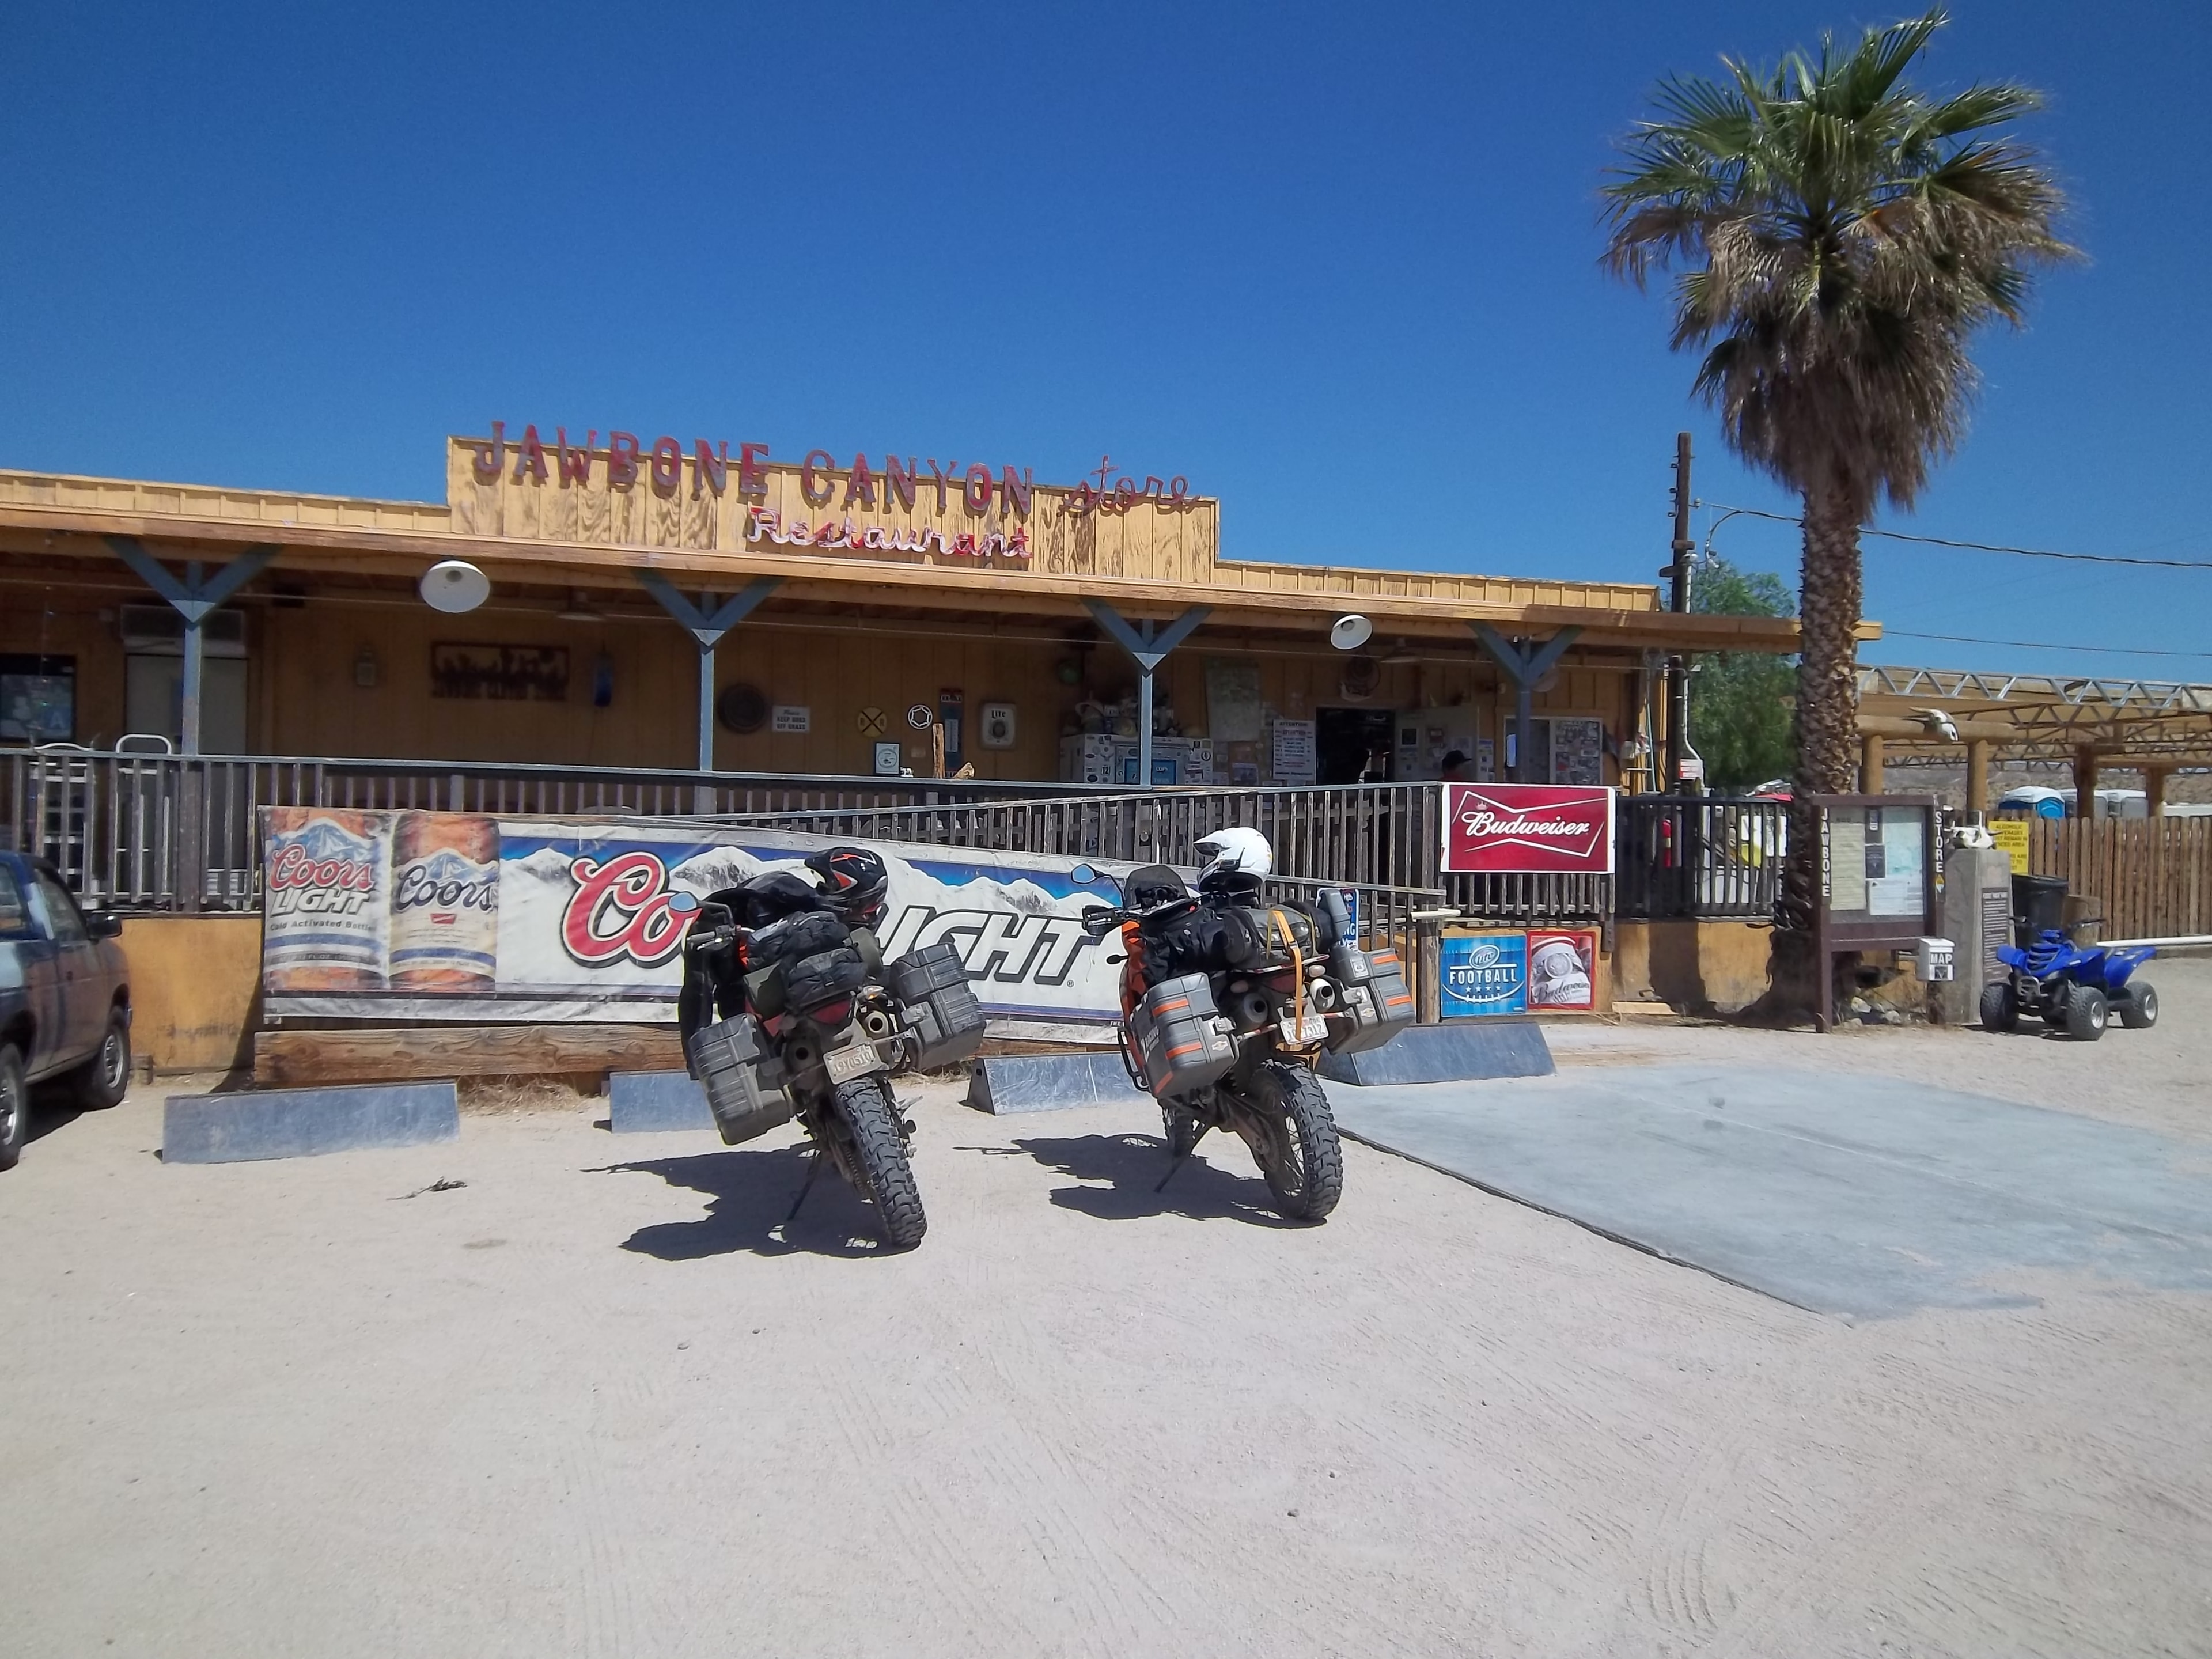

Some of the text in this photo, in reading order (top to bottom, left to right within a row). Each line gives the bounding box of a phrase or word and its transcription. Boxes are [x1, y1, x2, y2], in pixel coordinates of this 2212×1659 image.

[473, 421, 1201, 514] JAWBONE CANYON store
[749, 507, 1033, 559] Restaurant
[1461, 811, 1591, 836] Budweiser
[1935, 811, 1944, 873] STORE
[270, 843, 374, 891] Coors
[396, 864, 494, 913] Coors
[270, 888, 371, 918] LIGHT
[270, 923, 287, 931] Cold
[291, 919, 342, 928] Activated
[875, 903, 1115, 986] IGHT
[1931, 953, 1952, 964] MAP
[1449, 969, 1517, 985] FOOTBALL
